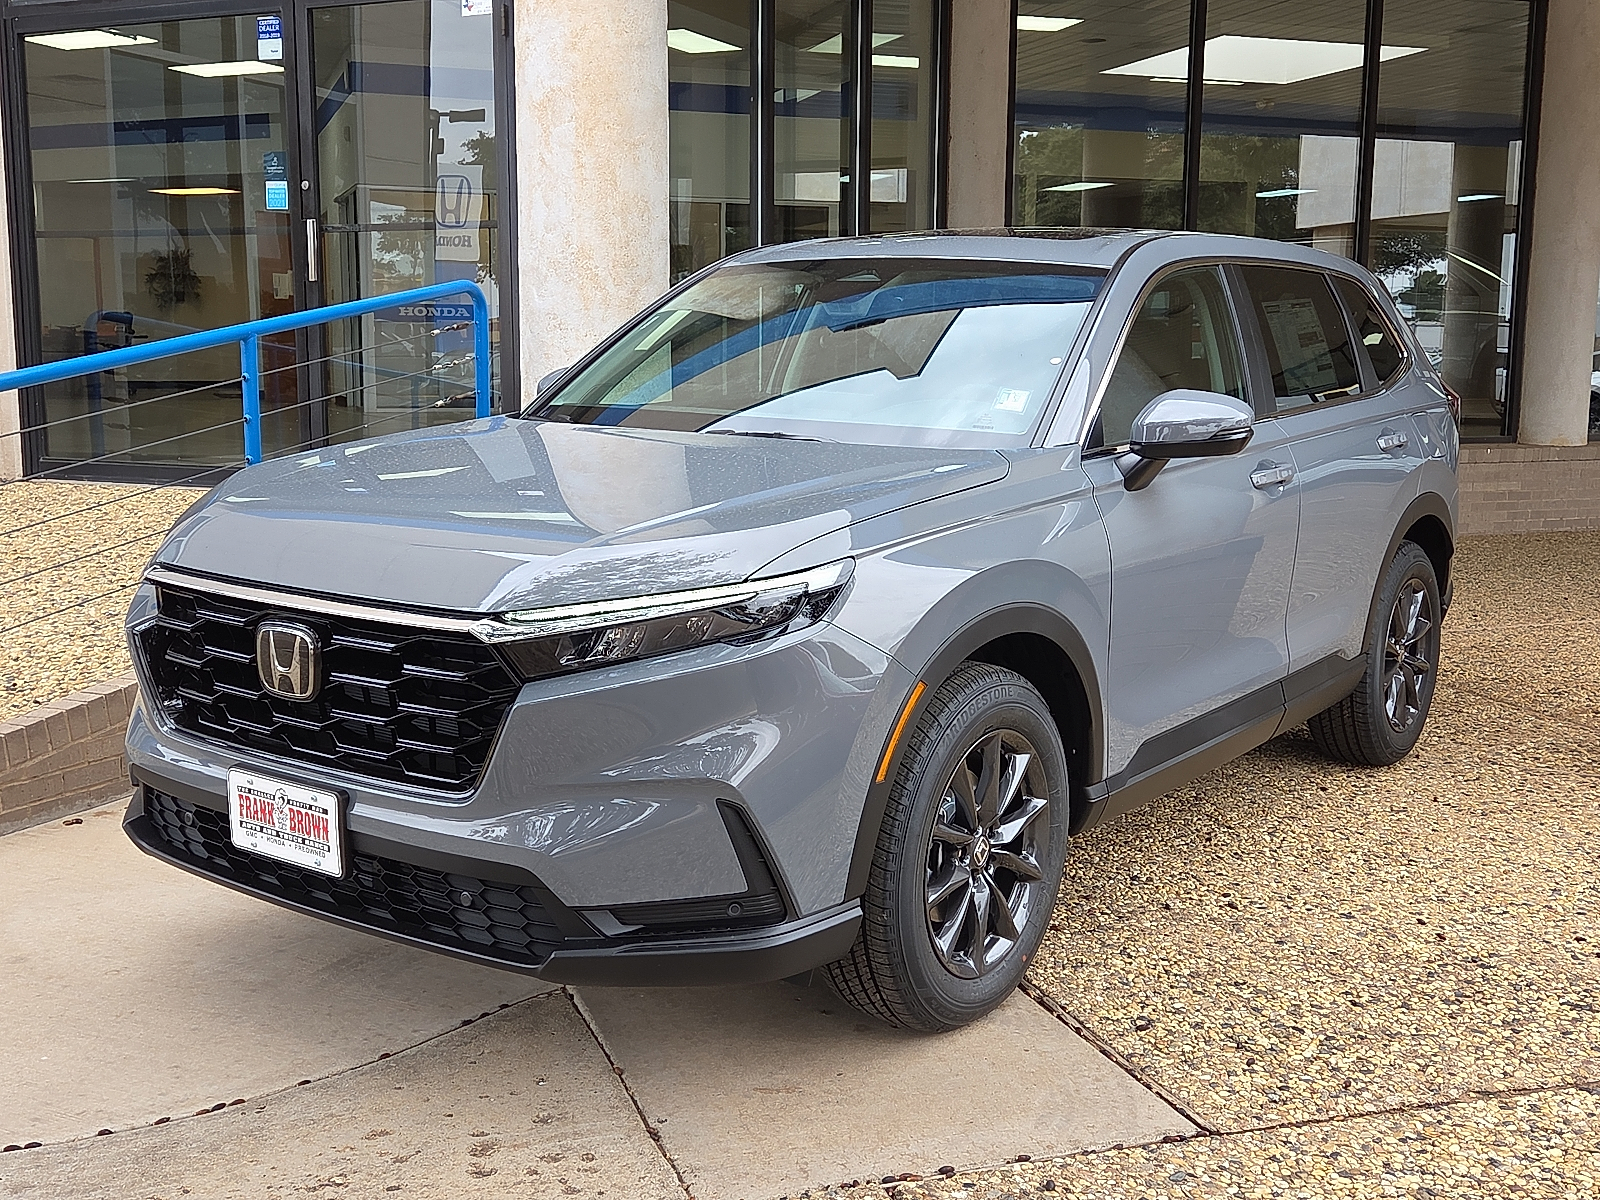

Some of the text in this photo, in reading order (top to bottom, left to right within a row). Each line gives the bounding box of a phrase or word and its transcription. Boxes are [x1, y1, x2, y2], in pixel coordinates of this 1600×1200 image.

[269, 199, 285, 207] 2021
[398, 306, 471, 317] HONDA
[237, 793, 330, 843] FRANK BROWN
[241, 821, 329, 852] AUTO AND TRUCK RANCH
[245, 830, 259, 839] GMC
[266, 836, 286, 848] HONDA
